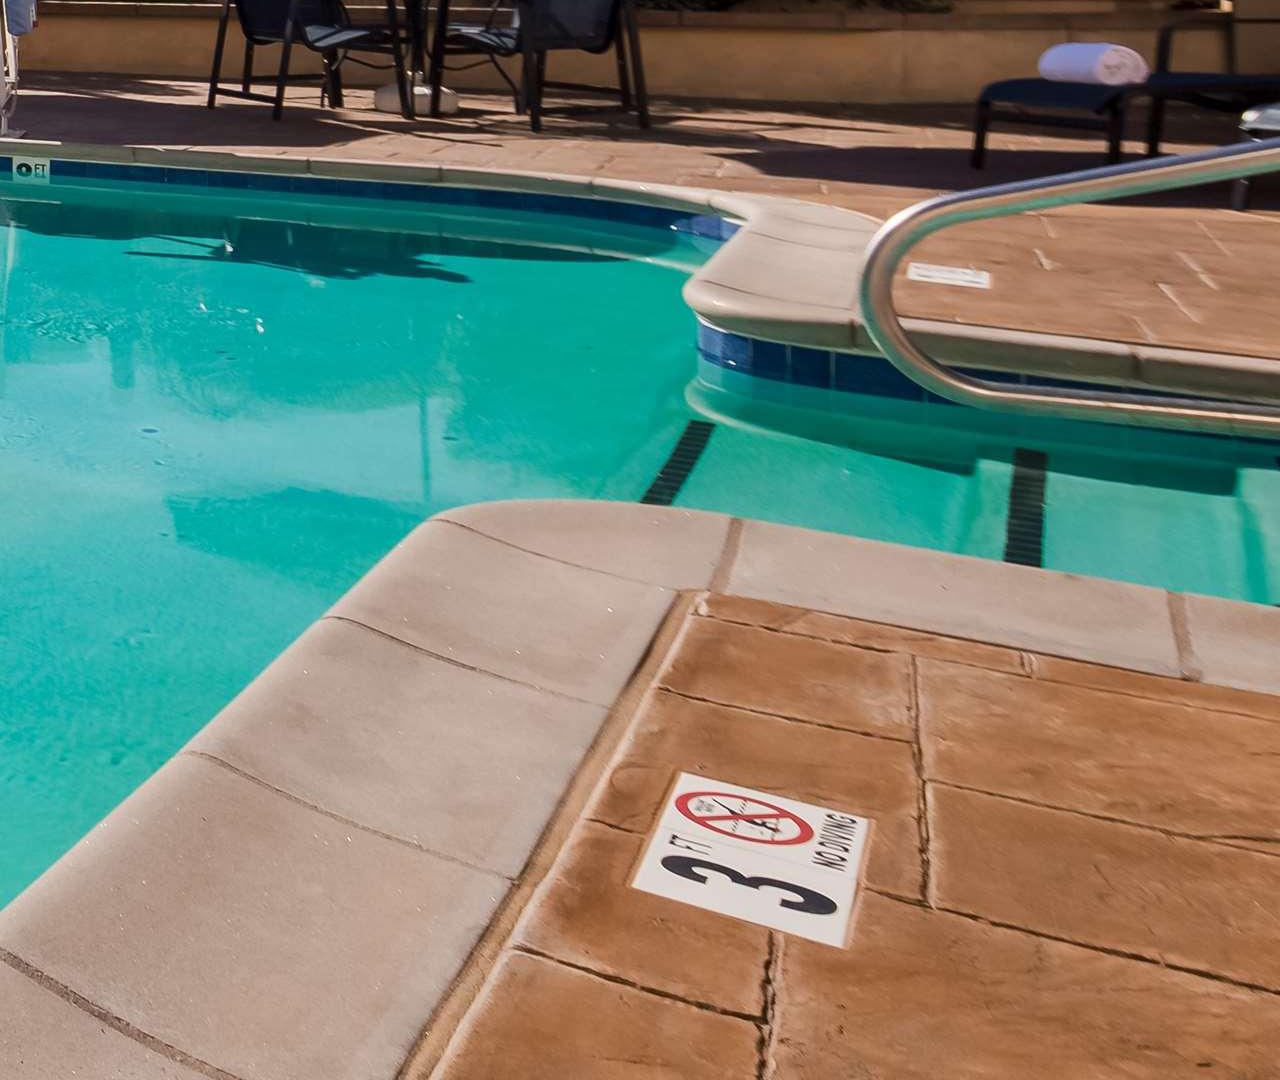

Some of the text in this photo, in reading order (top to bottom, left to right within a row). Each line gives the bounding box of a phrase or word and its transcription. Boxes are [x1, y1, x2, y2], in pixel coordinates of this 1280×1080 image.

[668, 833, 713, 856] FT
[811, 813, 858, 872] NO DIVING
[661, 855, 838, 916] 3
